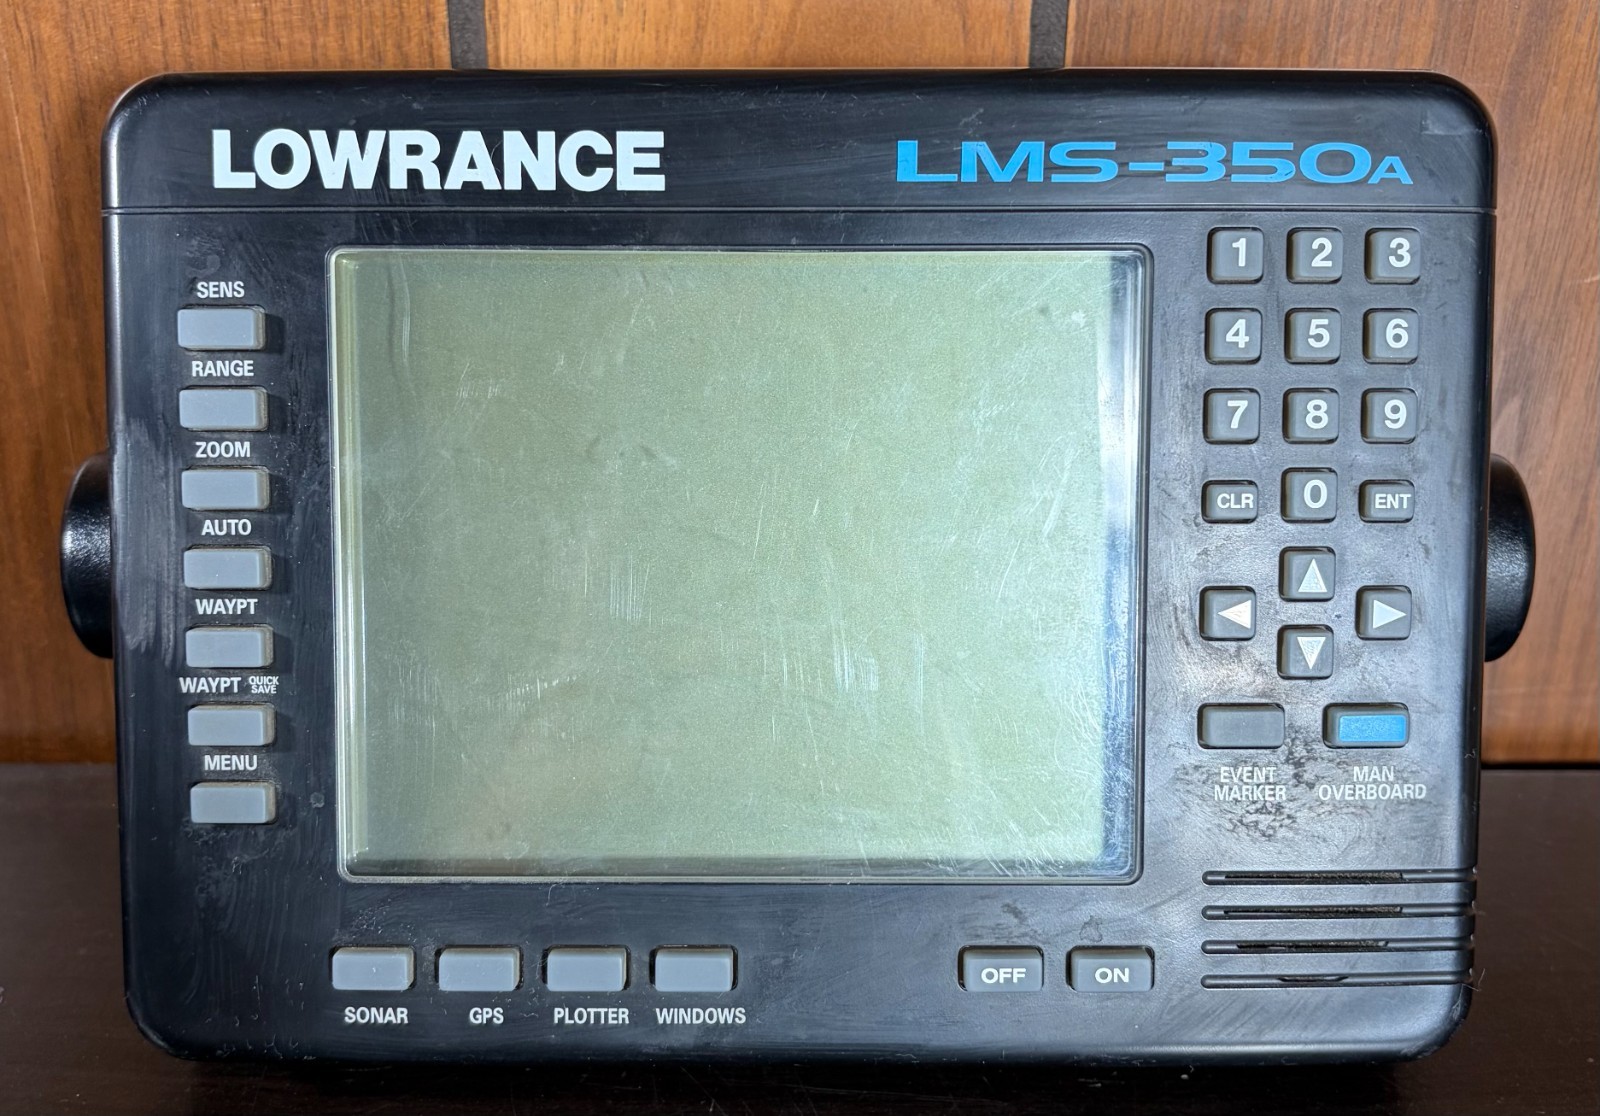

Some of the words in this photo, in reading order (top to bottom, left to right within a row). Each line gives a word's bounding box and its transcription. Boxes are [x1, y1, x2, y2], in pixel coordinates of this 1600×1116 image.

[213, 129, 665, 191] LOWRANCE
[897, 141, 1413, 184] LMS-350A
[1232, 238, 1246, 266] 1
[1312, 238, 1332, 266] 2
[1389, 238, 1410, 267] 3
[197, 281, 244, 298] SENS
[1226, 319, 1249, 348] 4
[1308, 319, 1330, 347] 5
[1386, 319, 1408, 348] 6
[192, 360, 254, 376] RANGE
[1228, 400, 1248, 428] 7
[1306, 400, 1328, 429] 8
[1385, 400, 1406, 429] 9
[196, 441, 250, 457] ZOOM
[1217, 494, 1253, 508] CLR
[1304, 480, 1327, 508] 0
[1375, 494, 1411, 508] ENT
[202, 519, 251, 535] AUTO
[195, 599, 258, 614] WAYPT
[179, 677, 241, 693] WAYPT
[248, 676, 279, 685] QUICK
[251, 684, 277, 694] SAVE
[205, 755, 257, 770] MENU
[1220, 766, 1276, 783] EVENT
[1353, 766, 1394, 782] MAN
[1214, 784, 1286, 801] MARKER
[1319, 784, 1426, 800] OVERBOARD
[981, 968, 1026, 983] OFF
[1095, 968, 1129, 983] ON
[345, 1007, 408, 1023] SONAR
[470, 1008, 503, 1024] GPS
[554, 1008, 629, 1024] PLOTTER
[656, 1008, 746, 1024] WINDOWS
